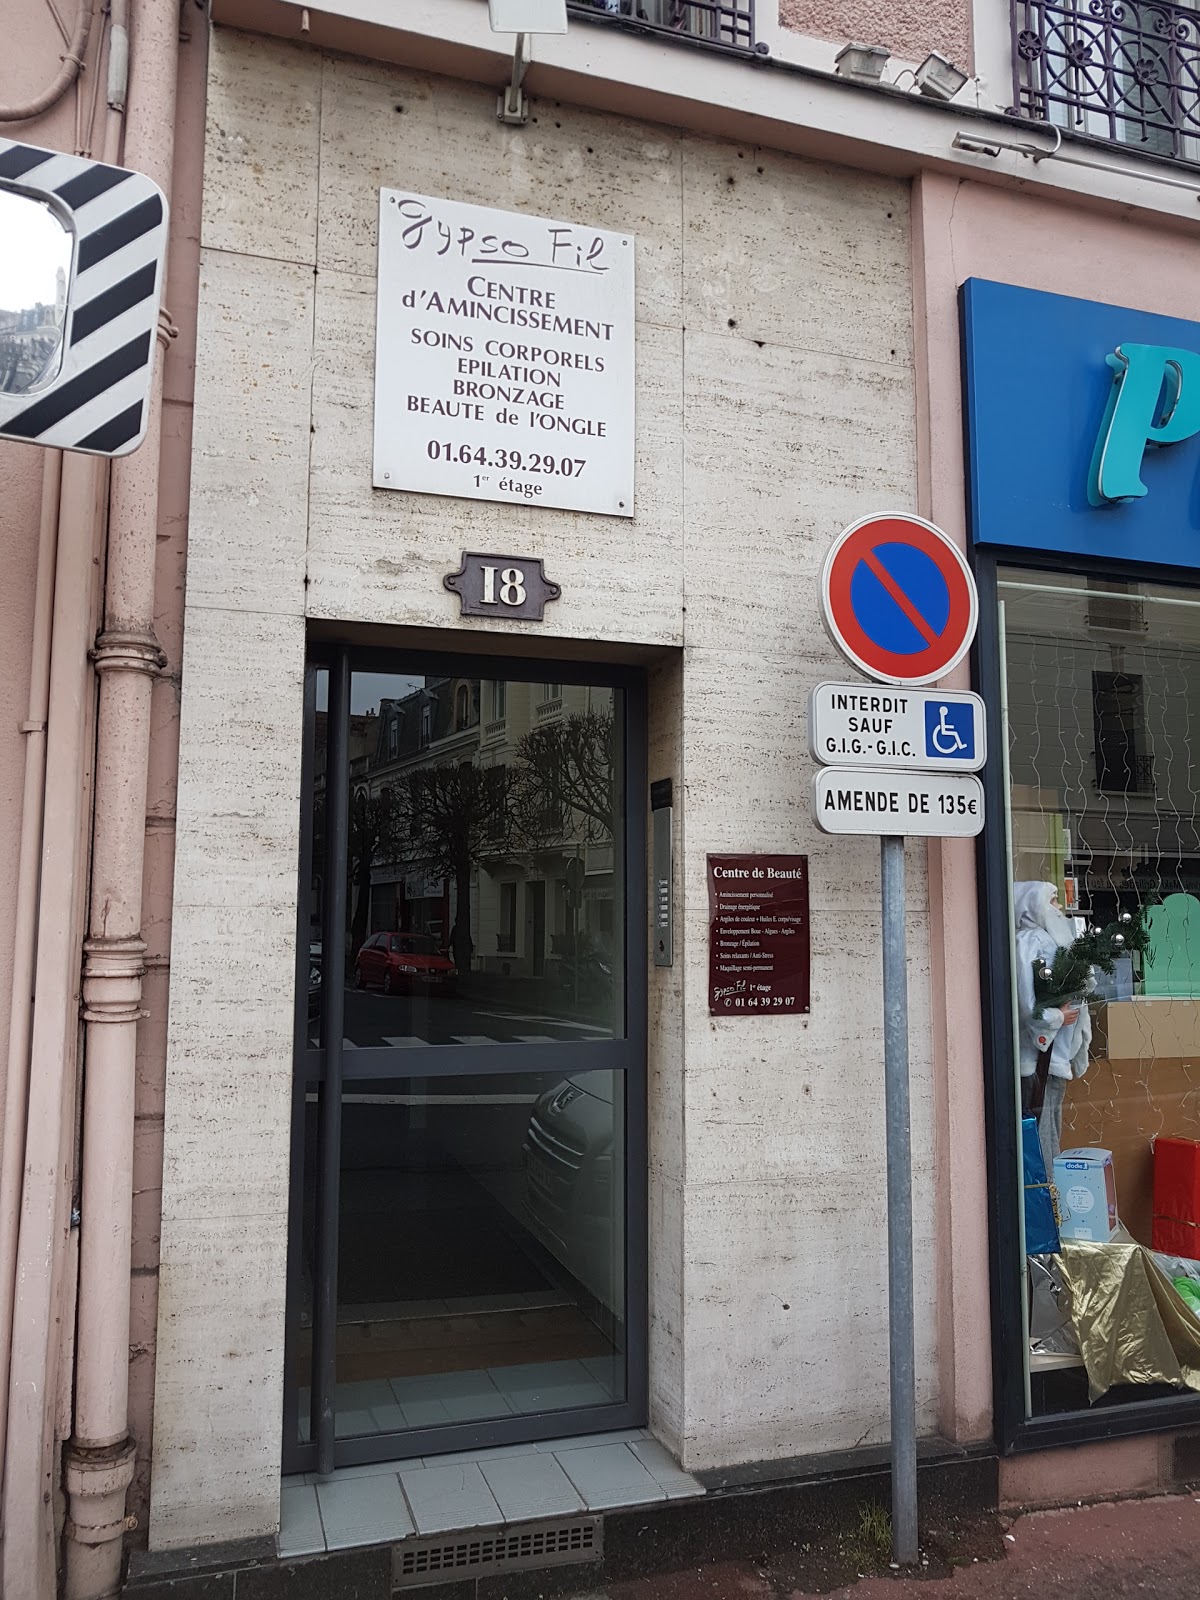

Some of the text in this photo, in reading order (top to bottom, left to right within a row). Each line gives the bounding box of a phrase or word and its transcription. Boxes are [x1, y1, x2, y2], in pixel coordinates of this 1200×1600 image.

[398, 199, 610, 272] Gypso Fil
[466, 275, 556, 310] CENTRE
[410, 328, 605, 372] SOINS CORPORELS
[457, 358, 561, 388] EPILATION
[452, 379, 564, 410] BRONZAGE
[407, 395, 607, 438] BEAUTE de l'ONGLE
[427, 440, 587, 478] 01.64.39.29.07
[498, 476, 543, 499] étage
[479, 565, 527, 606] 18
[831, 693, 908, 714] INTERDIT
[848, 716, 893, 734] SAUF
[824, 789, 978, 815] AMENDE DE 135€
[713, 866, 802, 879] Centre de Beauté
[719, 903, 738, 911] Drainage
[719, 915, 735, 924] Argiles
[719, 927, 750, 936] Enveloppement
[764, 927, 779, 936] Algues
[719, 939, 739, 949] Bronzage
[719, 964, 743, 972] Maquillage
[756, 983, 772, 992] étage
[735, 996, 796, 1007] 01 64 39 29 07
